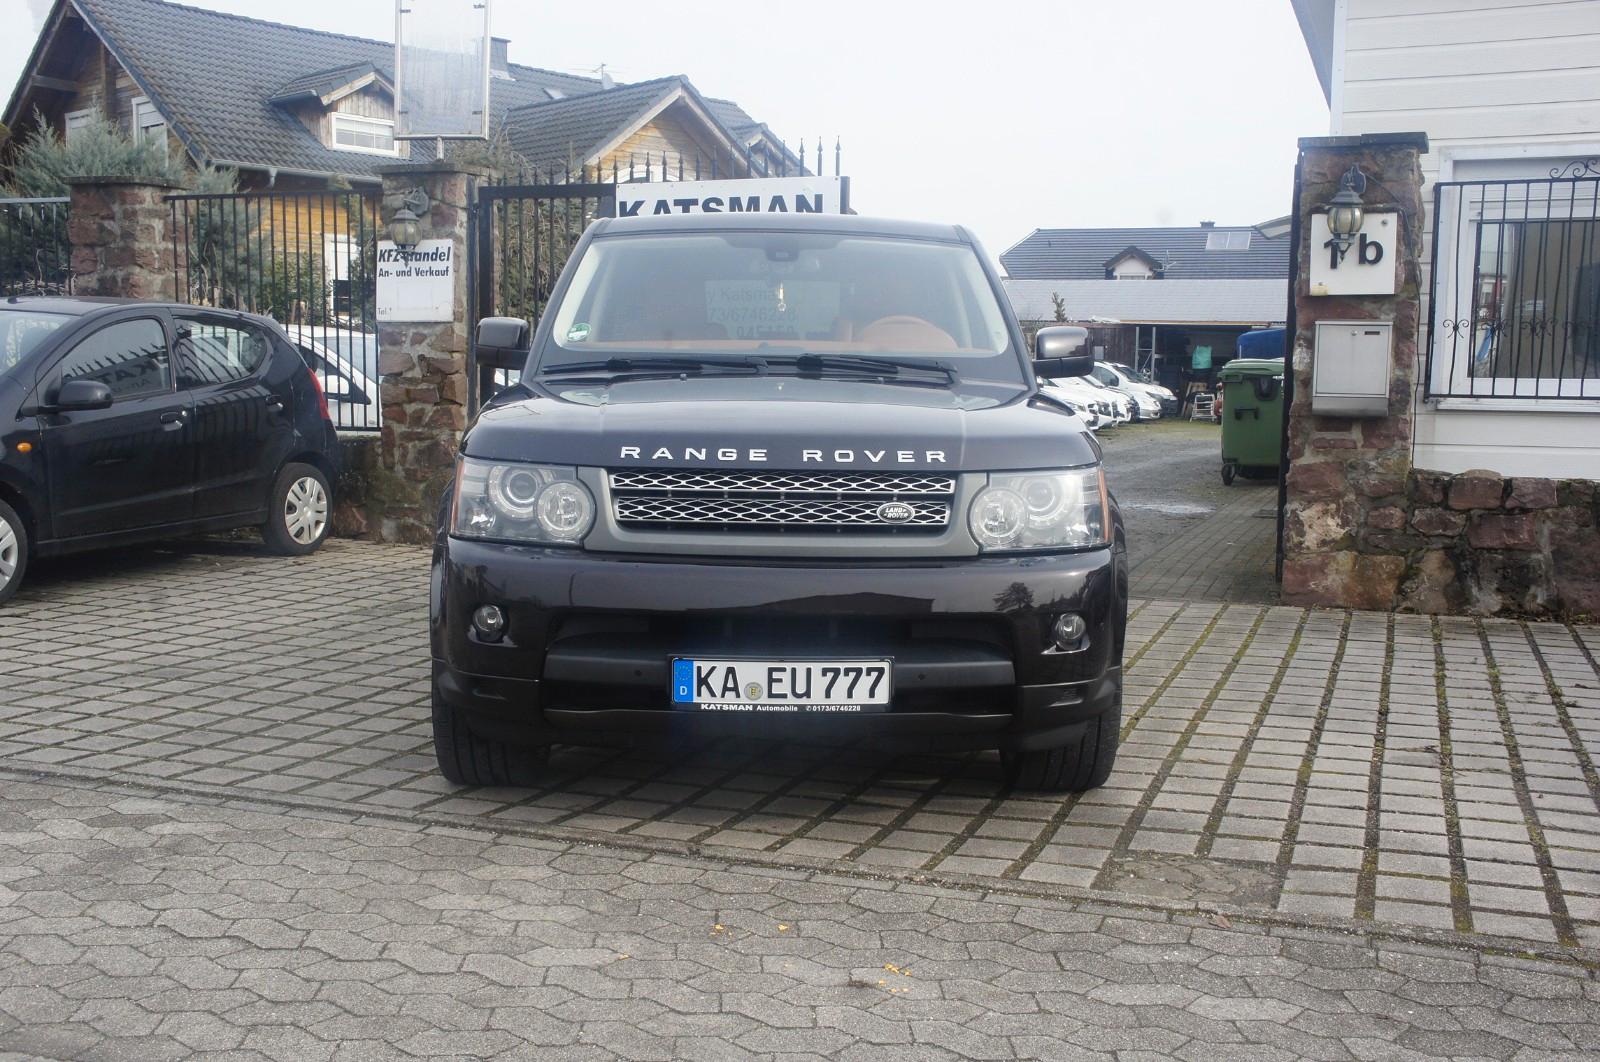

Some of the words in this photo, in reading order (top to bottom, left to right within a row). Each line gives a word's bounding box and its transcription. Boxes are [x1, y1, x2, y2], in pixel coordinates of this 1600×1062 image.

[619, 193, 824, 217] KATSMAN
[378, 267, 393, 277] An-
[396, 266, 412, 277] und
[414, 266, 449, 277] Verkauf
[620, 446, 768, 462] RANGE
[802, 449, 947, 463] ROVER
[696, 665, 741, 699] KA
[679, 686, 688, 696] D
[700, 703, 753, 711] KATSMAN
[756, 704, 798, 712] Automobile
